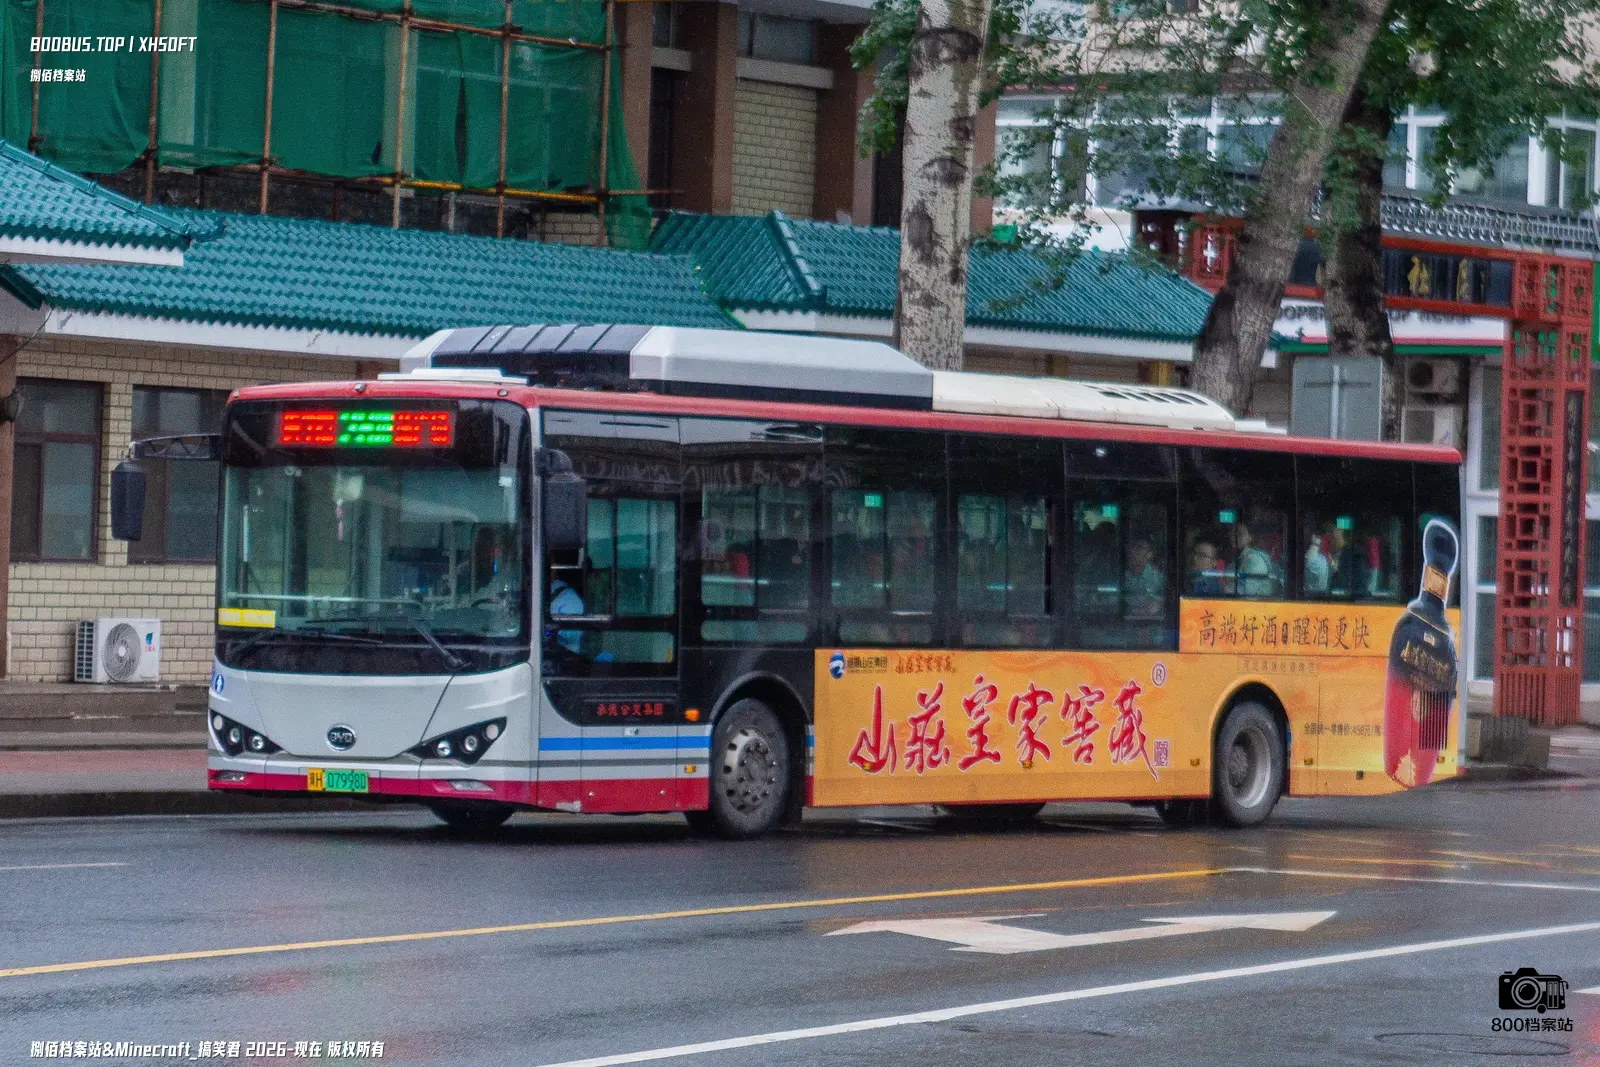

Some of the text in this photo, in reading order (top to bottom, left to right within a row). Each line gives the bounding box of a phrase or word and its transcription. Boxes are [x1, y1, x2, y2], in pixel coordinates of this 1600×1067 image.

[1199, 610, 1277, 648] 高端好酒
[1292, 616, 1369, 649] 醒酒更快
